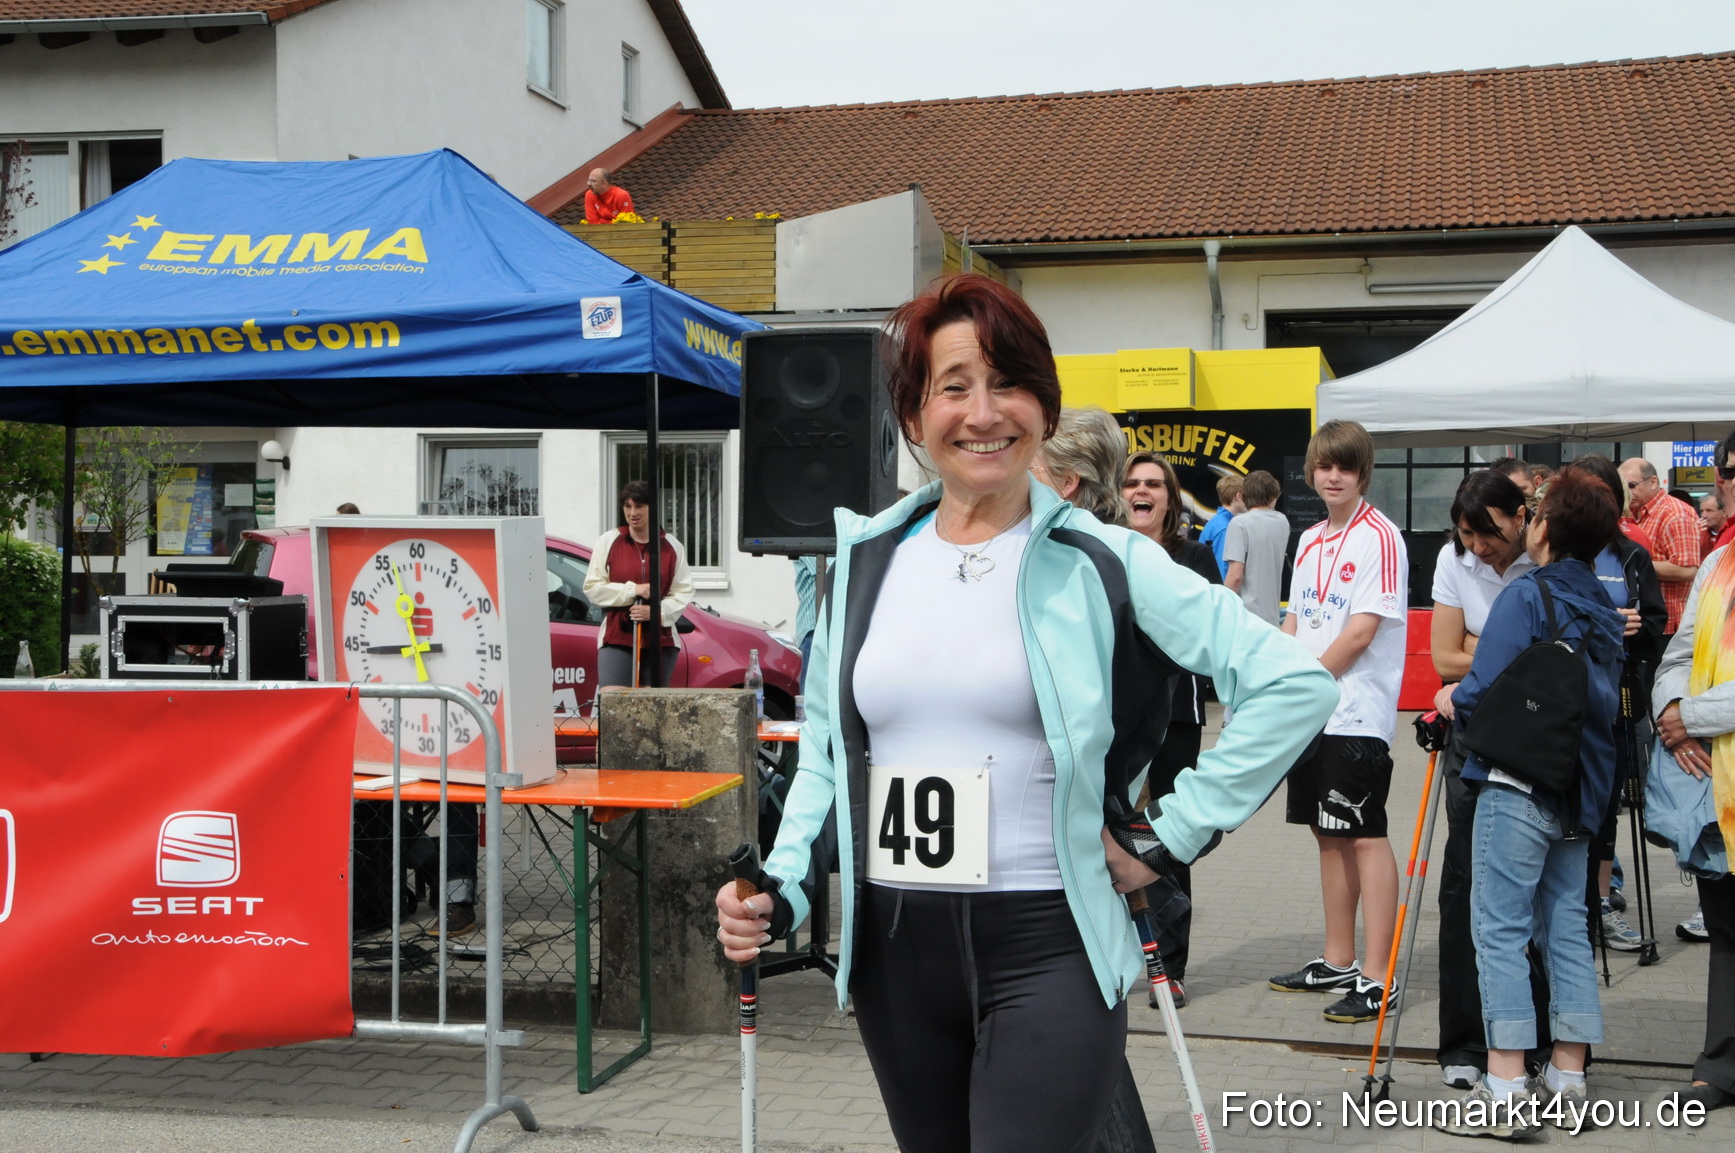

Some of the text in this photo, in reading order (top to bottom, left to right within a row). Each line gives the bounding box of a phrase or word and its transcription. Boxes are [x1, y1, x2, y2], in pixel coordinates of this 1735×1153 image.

[146, 227, 429, 265] EMMA
[139, 262, 425, 277] european mobile media association
[1673, 444, 1693, 453] Hier
[1673, 453, 1704, 467] TÜV
[409, 542, 425, 559] 60
[375, 555, 390, 571] 55
[450, 559, 459, 574] 5
[351, 591, 366, 606] 50
[478, 598, 492, 614] 10
[345, 636, 360, 652] 45
[489, 645, 502, 661] 15
[481, 690, 498, 706] 20
[380, 719, 394, 735] 35
[454, 728, 471, 744] 25
[418, 737, 435, 753] 30
[879, 776, 955, 869] 49
[132, 896, 264, 916] SEAT
[1194, 1113, 1211, 1151] Hiking
